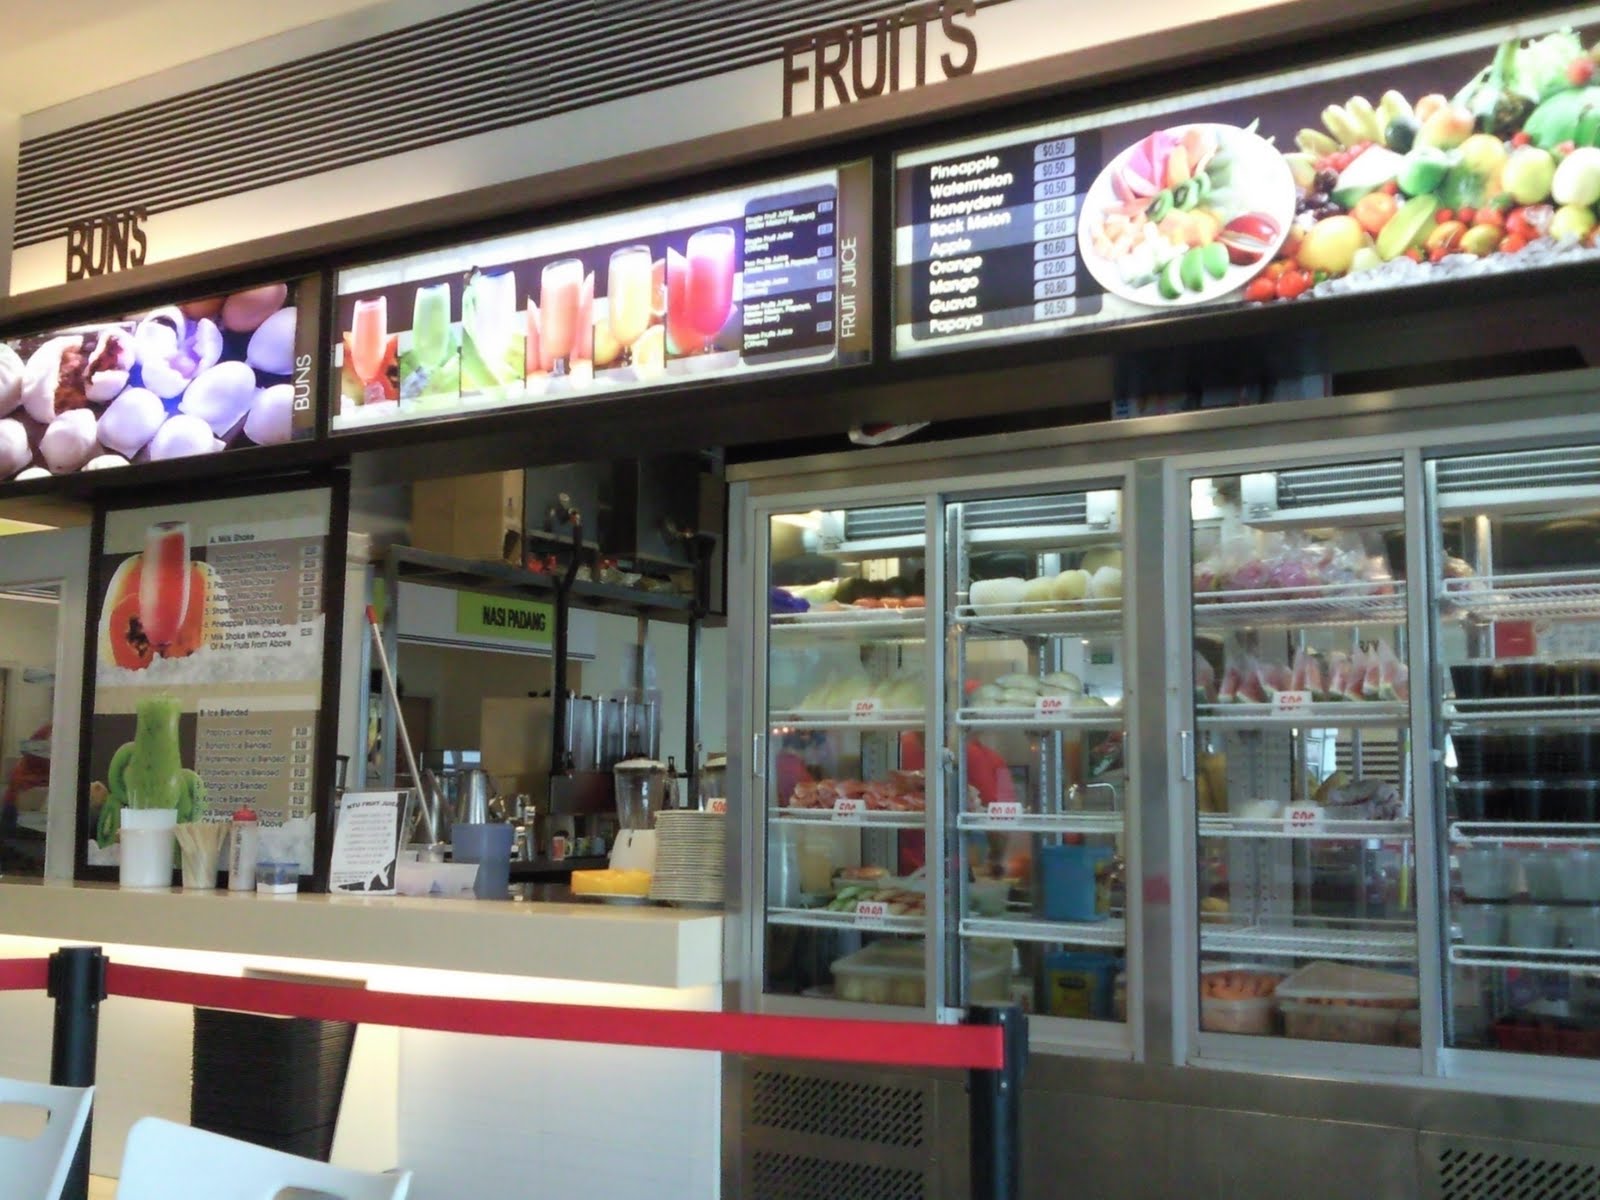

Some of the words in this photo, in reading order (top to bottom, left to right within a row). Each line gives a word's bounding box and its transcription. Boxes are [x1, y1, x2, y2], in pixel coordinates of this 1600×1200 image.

[782, 0, 978, 118] FRUITS
[930, 155, 999, 181] Pineapple
[930, 172, 1013, 199] Watermelon
[1043, 161, 1066, 177] $0.50
[930, 193, 1004, 219] Honeydew
[1043, 180, 1067, 196] $0.50
[930, 219, 964, 238] Rock
[967, 211, 1011, 231] Melon
[67, 205, 147, 281] BUNS
[930, 237, 972, 258] Apple
[841, 237, 857, 287] JUICE
[929, 255, 983, 276] Orange
[929, 276, 979, 295] Mango
[841, 293, 856, 337] FRUIT
[929, 295, 977, 314] Guava
[930, 314, 984, 333] Papaya
[295, 354, 311, 410] BUNS
[483, 606, 505, 627] NASI
[508, 609, 546, 632] PADANG
[225, 631, 246, 640] Shake
[262, 630, 286, 639] Choice
[269, 639, 291, 648] Above
[220, 708, 248, 717] Blended
